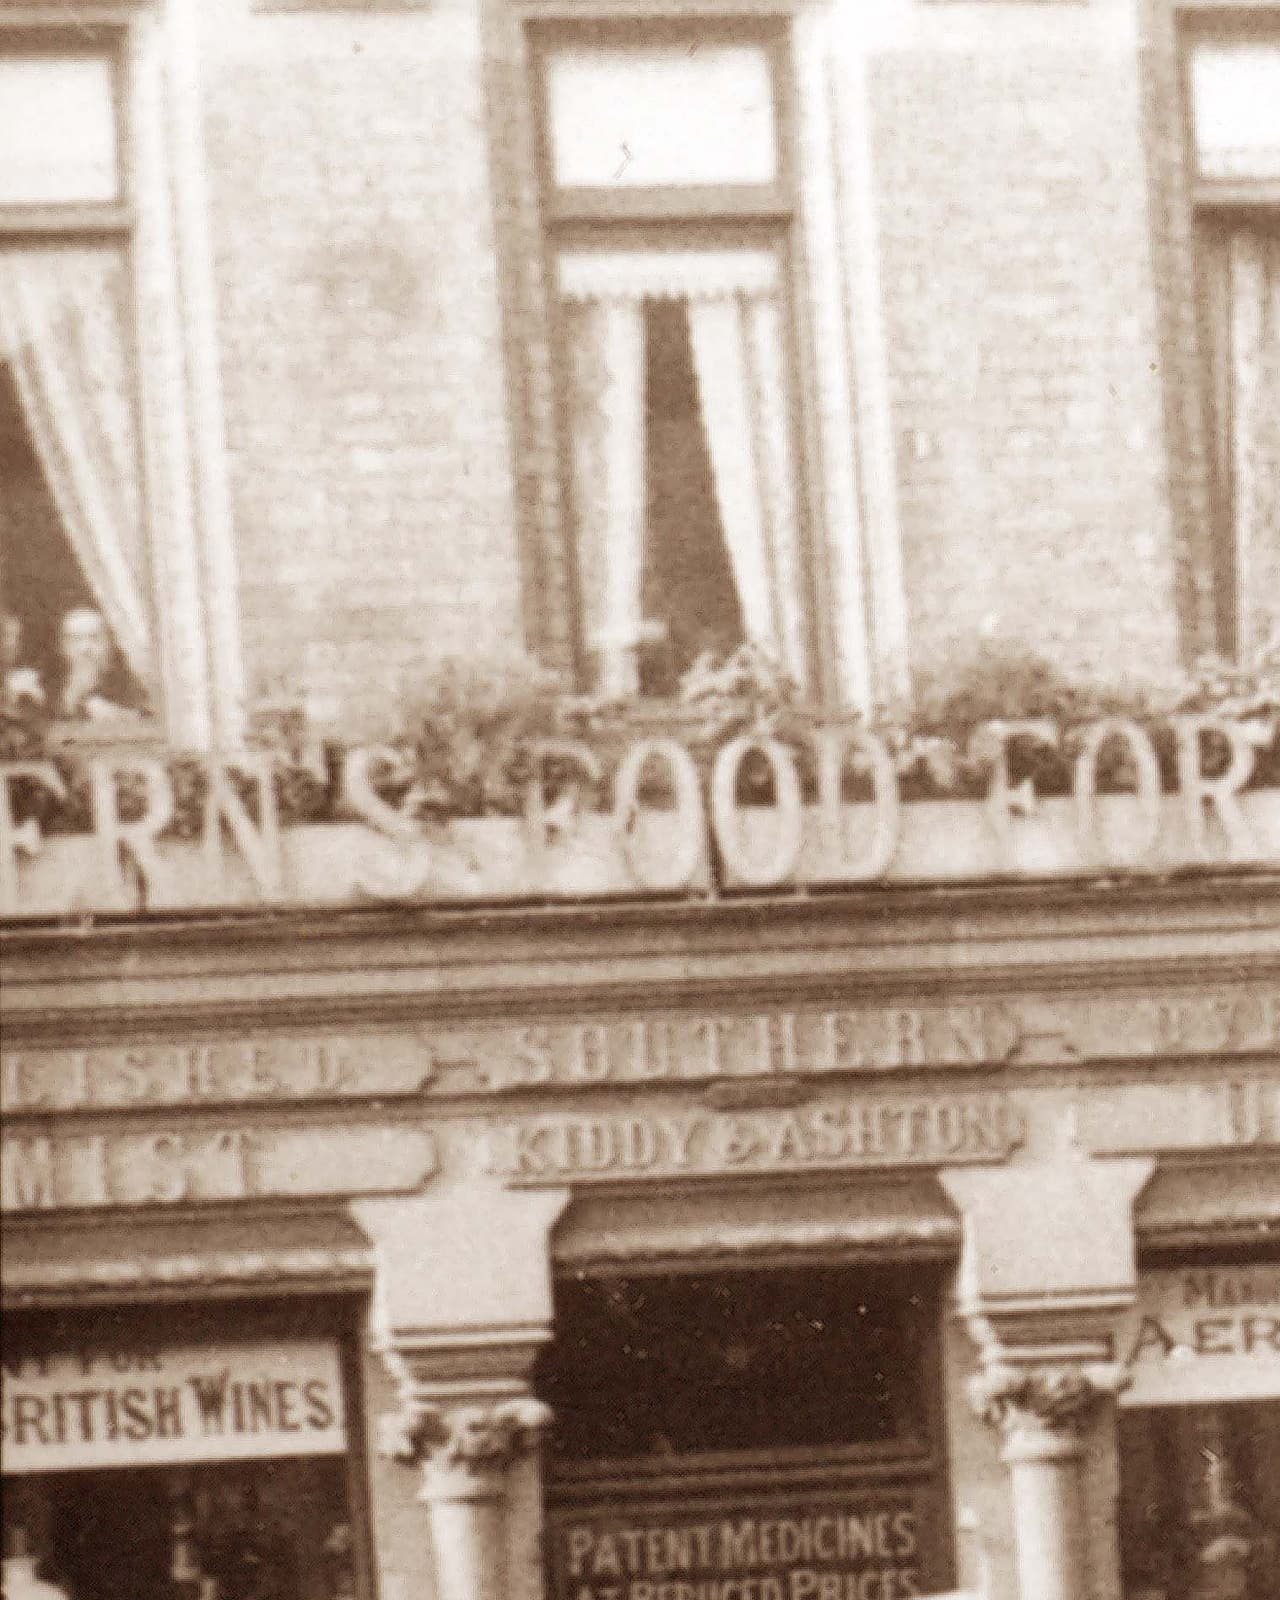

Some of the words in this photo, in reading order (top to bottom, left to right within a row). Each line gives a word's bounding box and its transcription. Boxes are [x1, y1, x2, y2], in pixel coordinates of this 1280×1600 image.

[524, 733, 898, 892] FOOD
[970, 714, 1272, 872] FOR
[517, 1007, 992, 1081] SOUTHERN
[0, 1384, 187, 1447] RITISH
[185, 1366, 337, 1435] WINES
[566, 1518, 714, 1578] PATENT
[718, 1511, 920, 1569] MEDICINES
